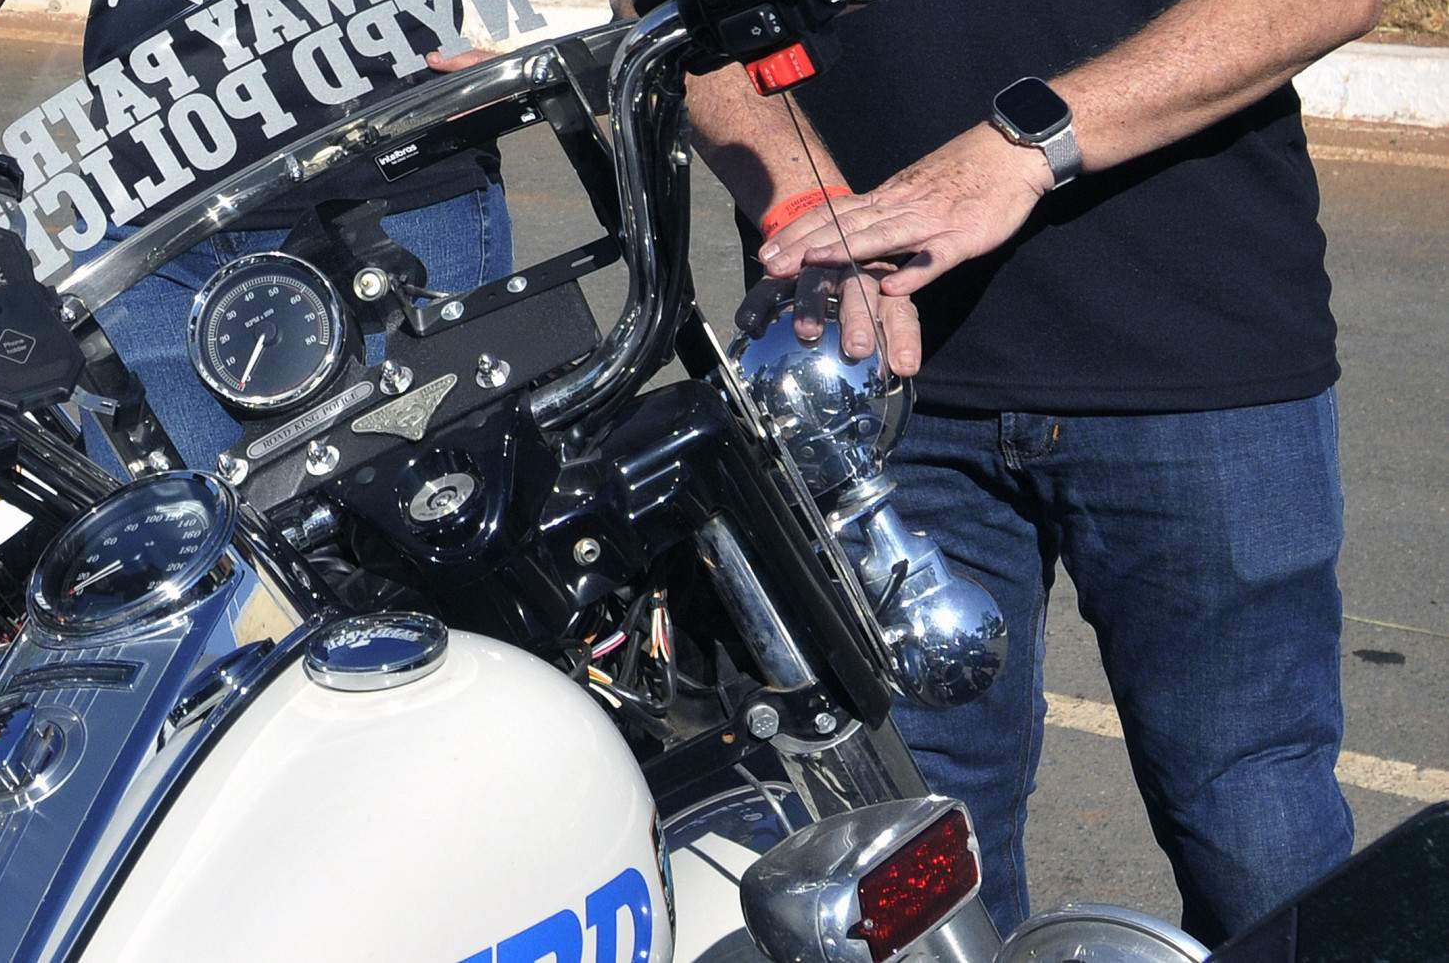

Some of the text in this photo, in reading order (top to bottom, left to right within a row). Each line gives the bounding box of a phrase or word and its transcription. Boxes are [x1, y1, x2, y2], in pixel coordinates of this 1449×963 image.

[244, 292, 254, 302] 40
[268, 287, 279, 297] 50
[290, 294, 301, 305] 60
[226, 310, 237, 320] 30
[304, 312, 316, 322] 70
[220, 334, 230, 344] 20
[305, 335, 317, 346] 80
[225, 358, 236, 367] 10
[263, 392, 359, 450] ROAD KING POLICE
[124, 523, 138, 532] 80
[103, 537, 117, 546] 60
[86, 554, 99, 564] 40
